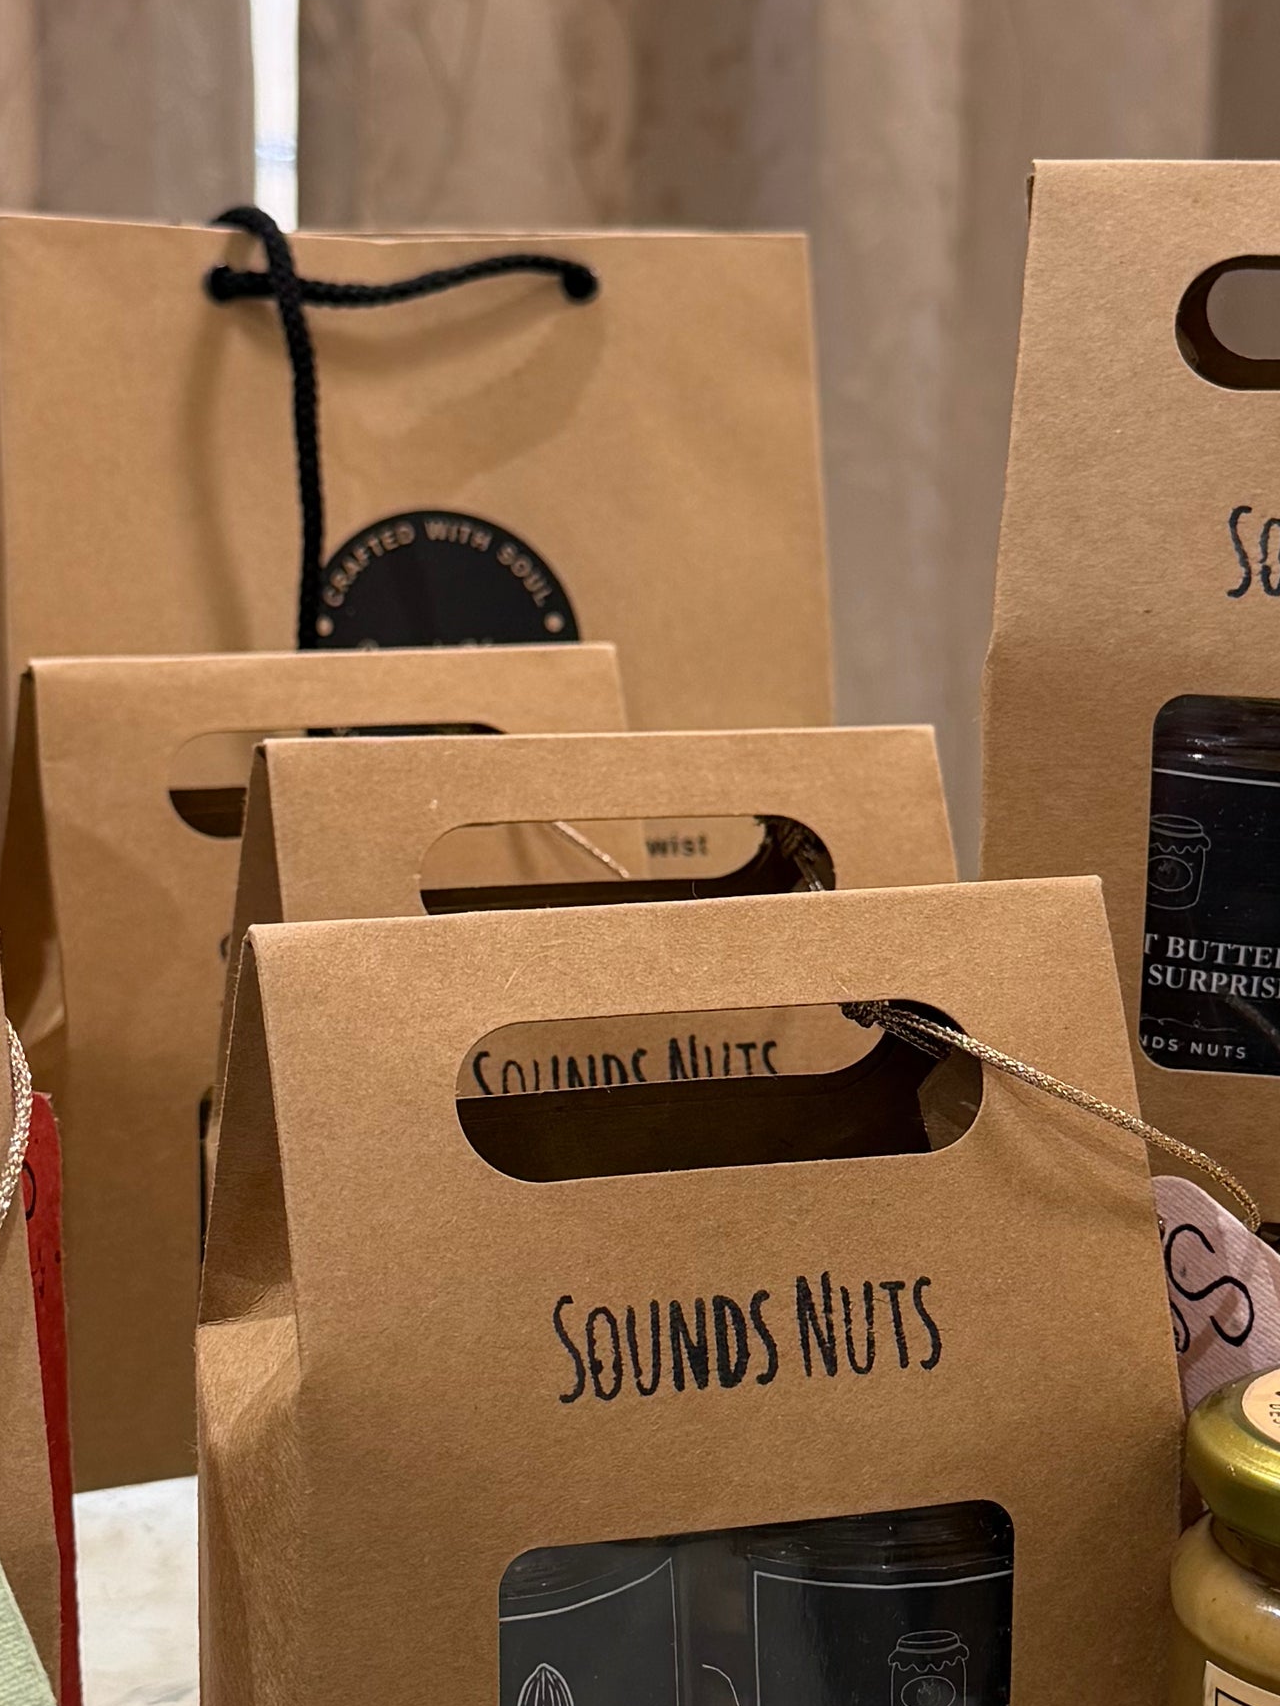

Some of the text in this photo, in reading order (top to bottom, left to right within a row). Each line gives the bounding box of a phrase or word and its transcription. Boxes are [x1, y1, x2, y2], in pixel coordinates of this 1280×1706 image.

[322, 519, 553, 608] CRAFTED WITH SOUL
[1190, 1041, 1247, 1060] NUTS
[553, 1271, 942, 1403] SOUNDS NUTS
